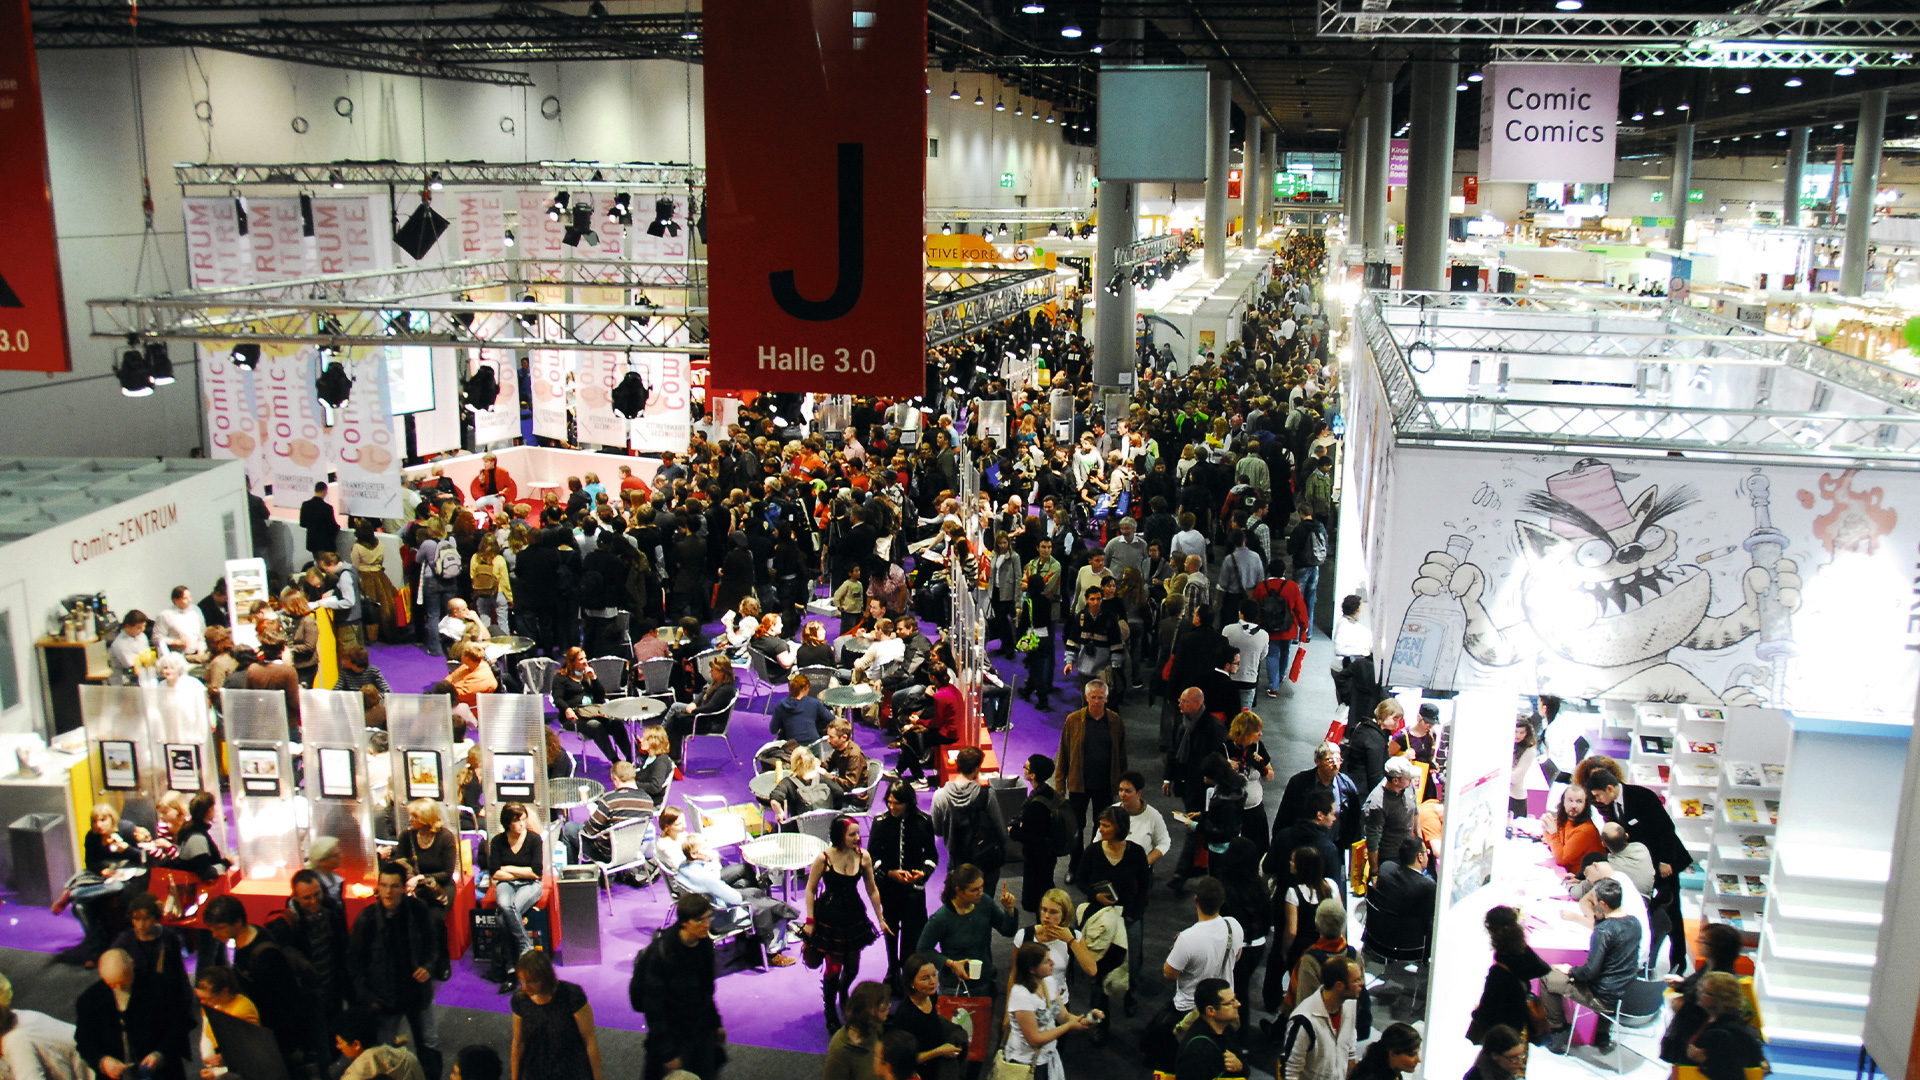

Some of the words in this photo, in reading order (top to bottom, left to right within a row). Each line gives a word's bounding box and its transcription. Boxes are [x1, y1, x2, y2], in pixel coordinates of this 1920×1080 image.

[1507, 87, 1591, 110] Comic
[1505, 120, 1604, 143] Comics
[1229, 183, 1238, 194] K
[1466, 189, 1476, 200] G
[769, 143, 864, 321] J
[926, 247, 959, 260] TIVE
[758, 345, 825, 371] Halle
[834, 348, 876, 374] 3.0
[71, 502, 178, 565] Comic-ZENTRUM
